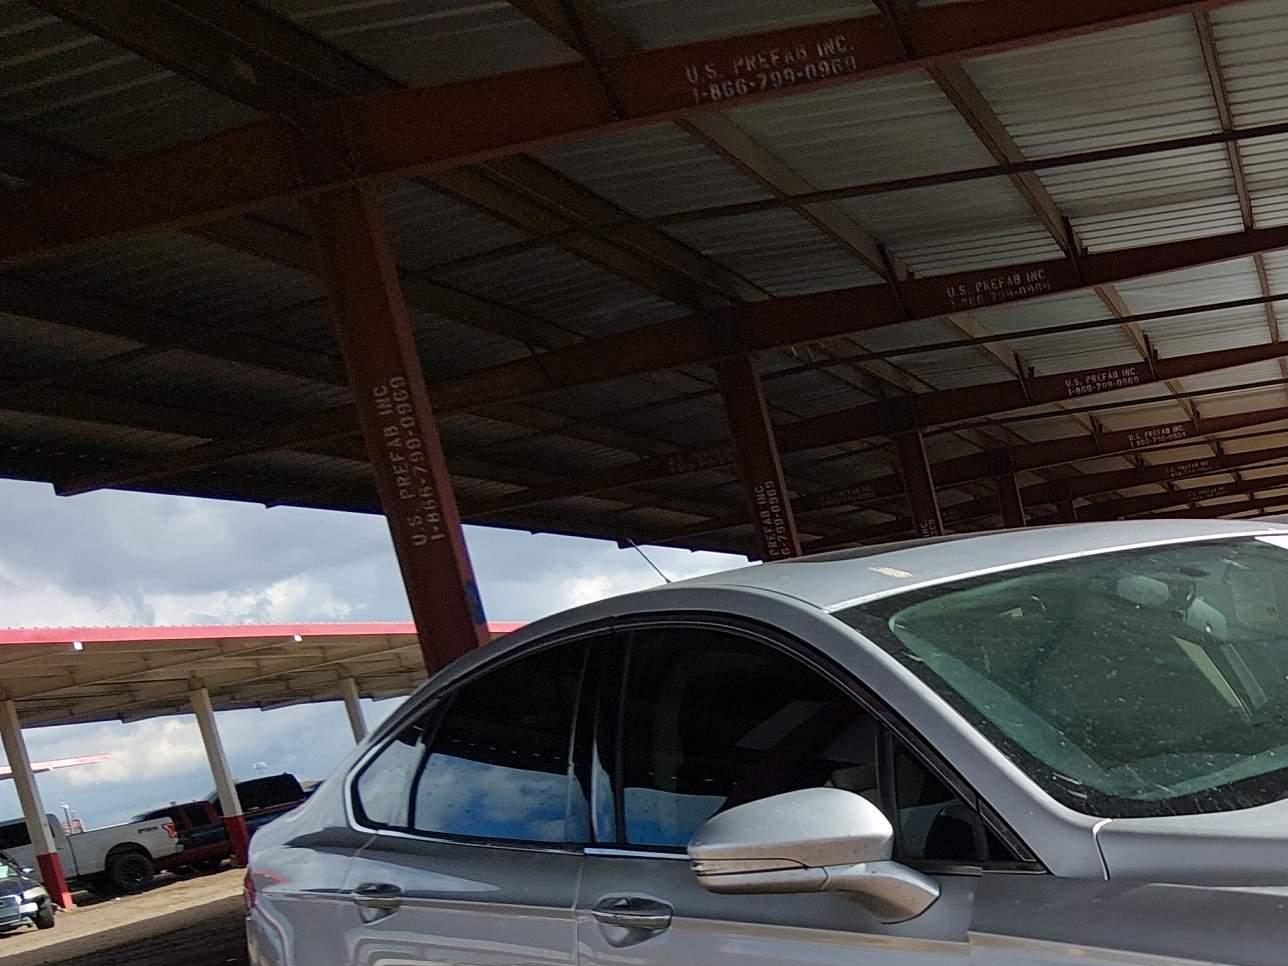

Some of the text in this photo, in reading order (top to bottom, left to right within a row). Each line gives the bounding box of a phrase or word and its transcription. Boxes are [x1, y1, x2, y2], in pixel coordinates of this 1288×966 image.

[733, 46, 809, 75] PREFAB
[816, 34, 856, 58] INC.
[975, 272, 1021, 293] PREFAB
[1085, 370, 1119, 385] PREFAB
[383, 424, 416, 500] PREFAB
[760, 510, 780, 556] PREFAB
